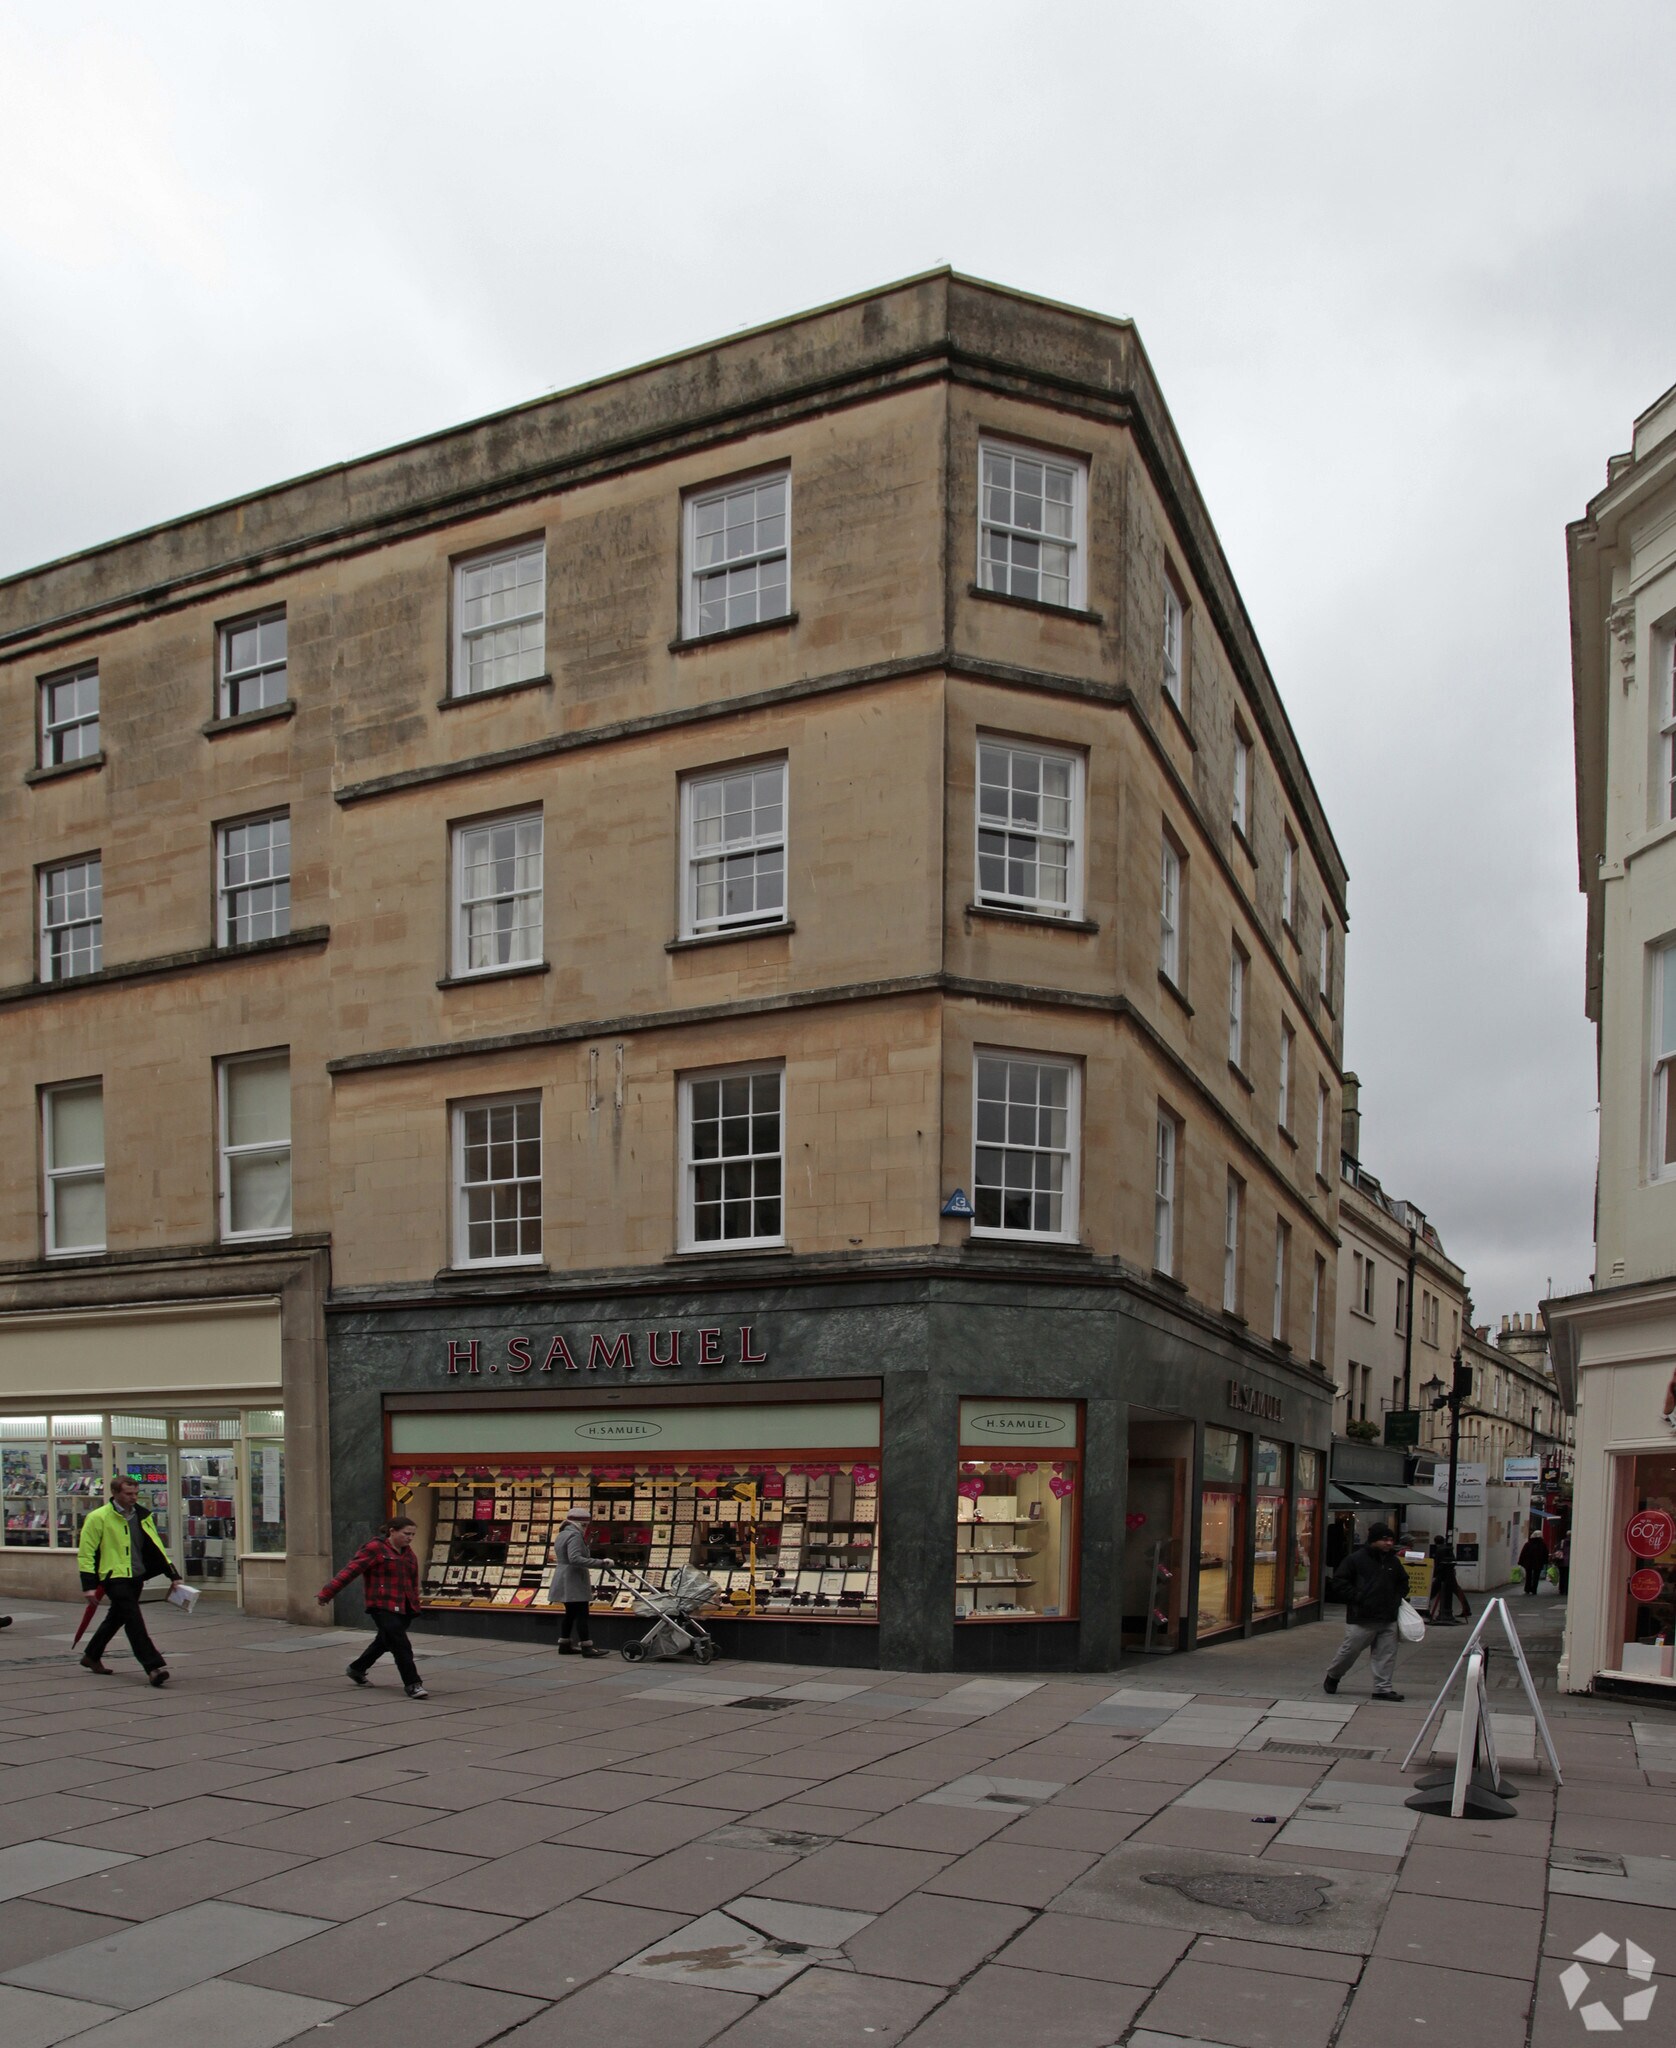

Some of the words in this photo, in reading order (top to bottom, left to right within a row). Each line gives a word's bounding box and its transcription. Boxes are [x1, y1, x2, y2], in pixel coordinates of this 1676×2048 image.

[446, 1326, 767, 1375] H.SAMUEL
[1229, 1380, 1285, 1423] H.SAMUEL
[589, 1425, 648, 1435] H.SAMUEL
[986, 1419, 1051, 1429] H.SAMUEL
[1631, 1522, 1665, 1538] 60%
